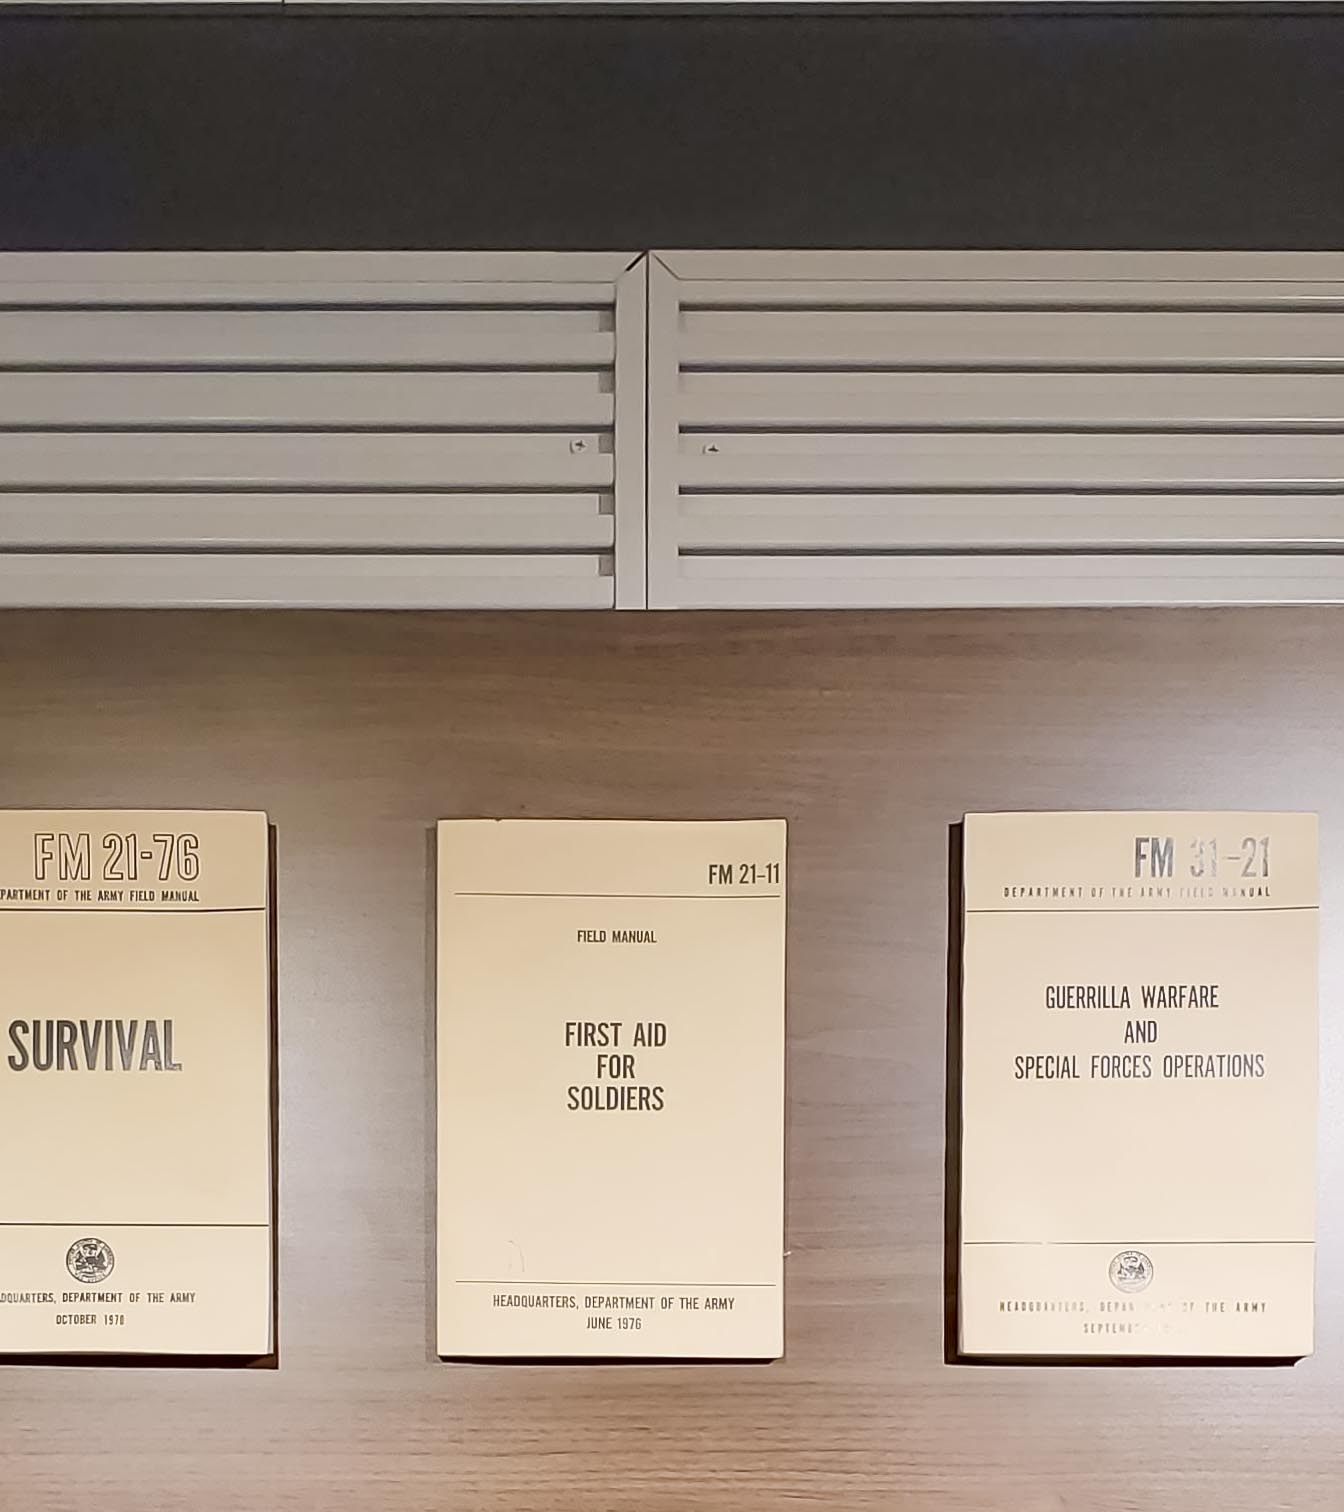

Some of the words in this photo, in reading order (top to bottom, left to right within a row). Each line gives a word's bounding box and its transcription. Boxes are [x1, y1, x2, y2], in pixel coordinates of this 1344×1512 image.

[34, 833, 90, 880] FM
[103, 833, 199, 880] 21-76
[1134, 837, 1174, 877] FM
[709, 864, 733, 884] FM
[57, 890, 67, 901] OF
[75, 890, 91, 901] THE
[98, 890, 123, 902] ARMY
[130, 890, 154, 902] FIELD
[161, 890, 199, 902] MANUAL
[1004, 887, 1082, 897] DEPARTMENT
[1091, 887, 1104, 897] OF
[1112, 887, 1132, 897] THE
[1140, 887, 1170, 897] ARMY
[577, 930, 606, 943] FIELD
[612, 930, 657, 943] MANUAL
[1046, 986, 1130, 1009] GUERRILLA
[1141, 985, 1219, 1008] WARFARE
[565, 1022, 622, 1047] FIRST
[633, 1022, 667, 1047] AID
[1124, 1021, 1157, 1042] AND
[8, 1020, 182, 1071] SURVIVAL
[597, 1054, 635, 1079] FOR
[1015, 1056, 1080, 1078] SPECIAL
[1091, 1056, 1152, 1078] FORCES
[1163, 1054, 1265, 1077] OPERATIONS
[567, 1086, 664, 1110] SOLDIERS
[62, 1292, 122, 1303] DEPARTMENT
[130, 1292, 140, 1303] OF
[147, 1292, 164, 1303] THE
[170, 1292, 196, 1303] ARMY
[493, 1295, 579, 1309] HEADQUARTERS,
[585, 1296, 654, 1309] DEPARTMENT
[660, 1297, 674, 1309] OF
[679, 1297, 699, 1309] THE
[704, 1298, 734, 1310] ARMY
[1205, 1302, 1225, 1312] THE
[1236, 1302, 1266, 1312] ARMY
[56, 1314, 96, 1325] OCTOBER
[586, 1317, 612, 1330] JUNE
[617, 1317, 641, 1330] 1976
